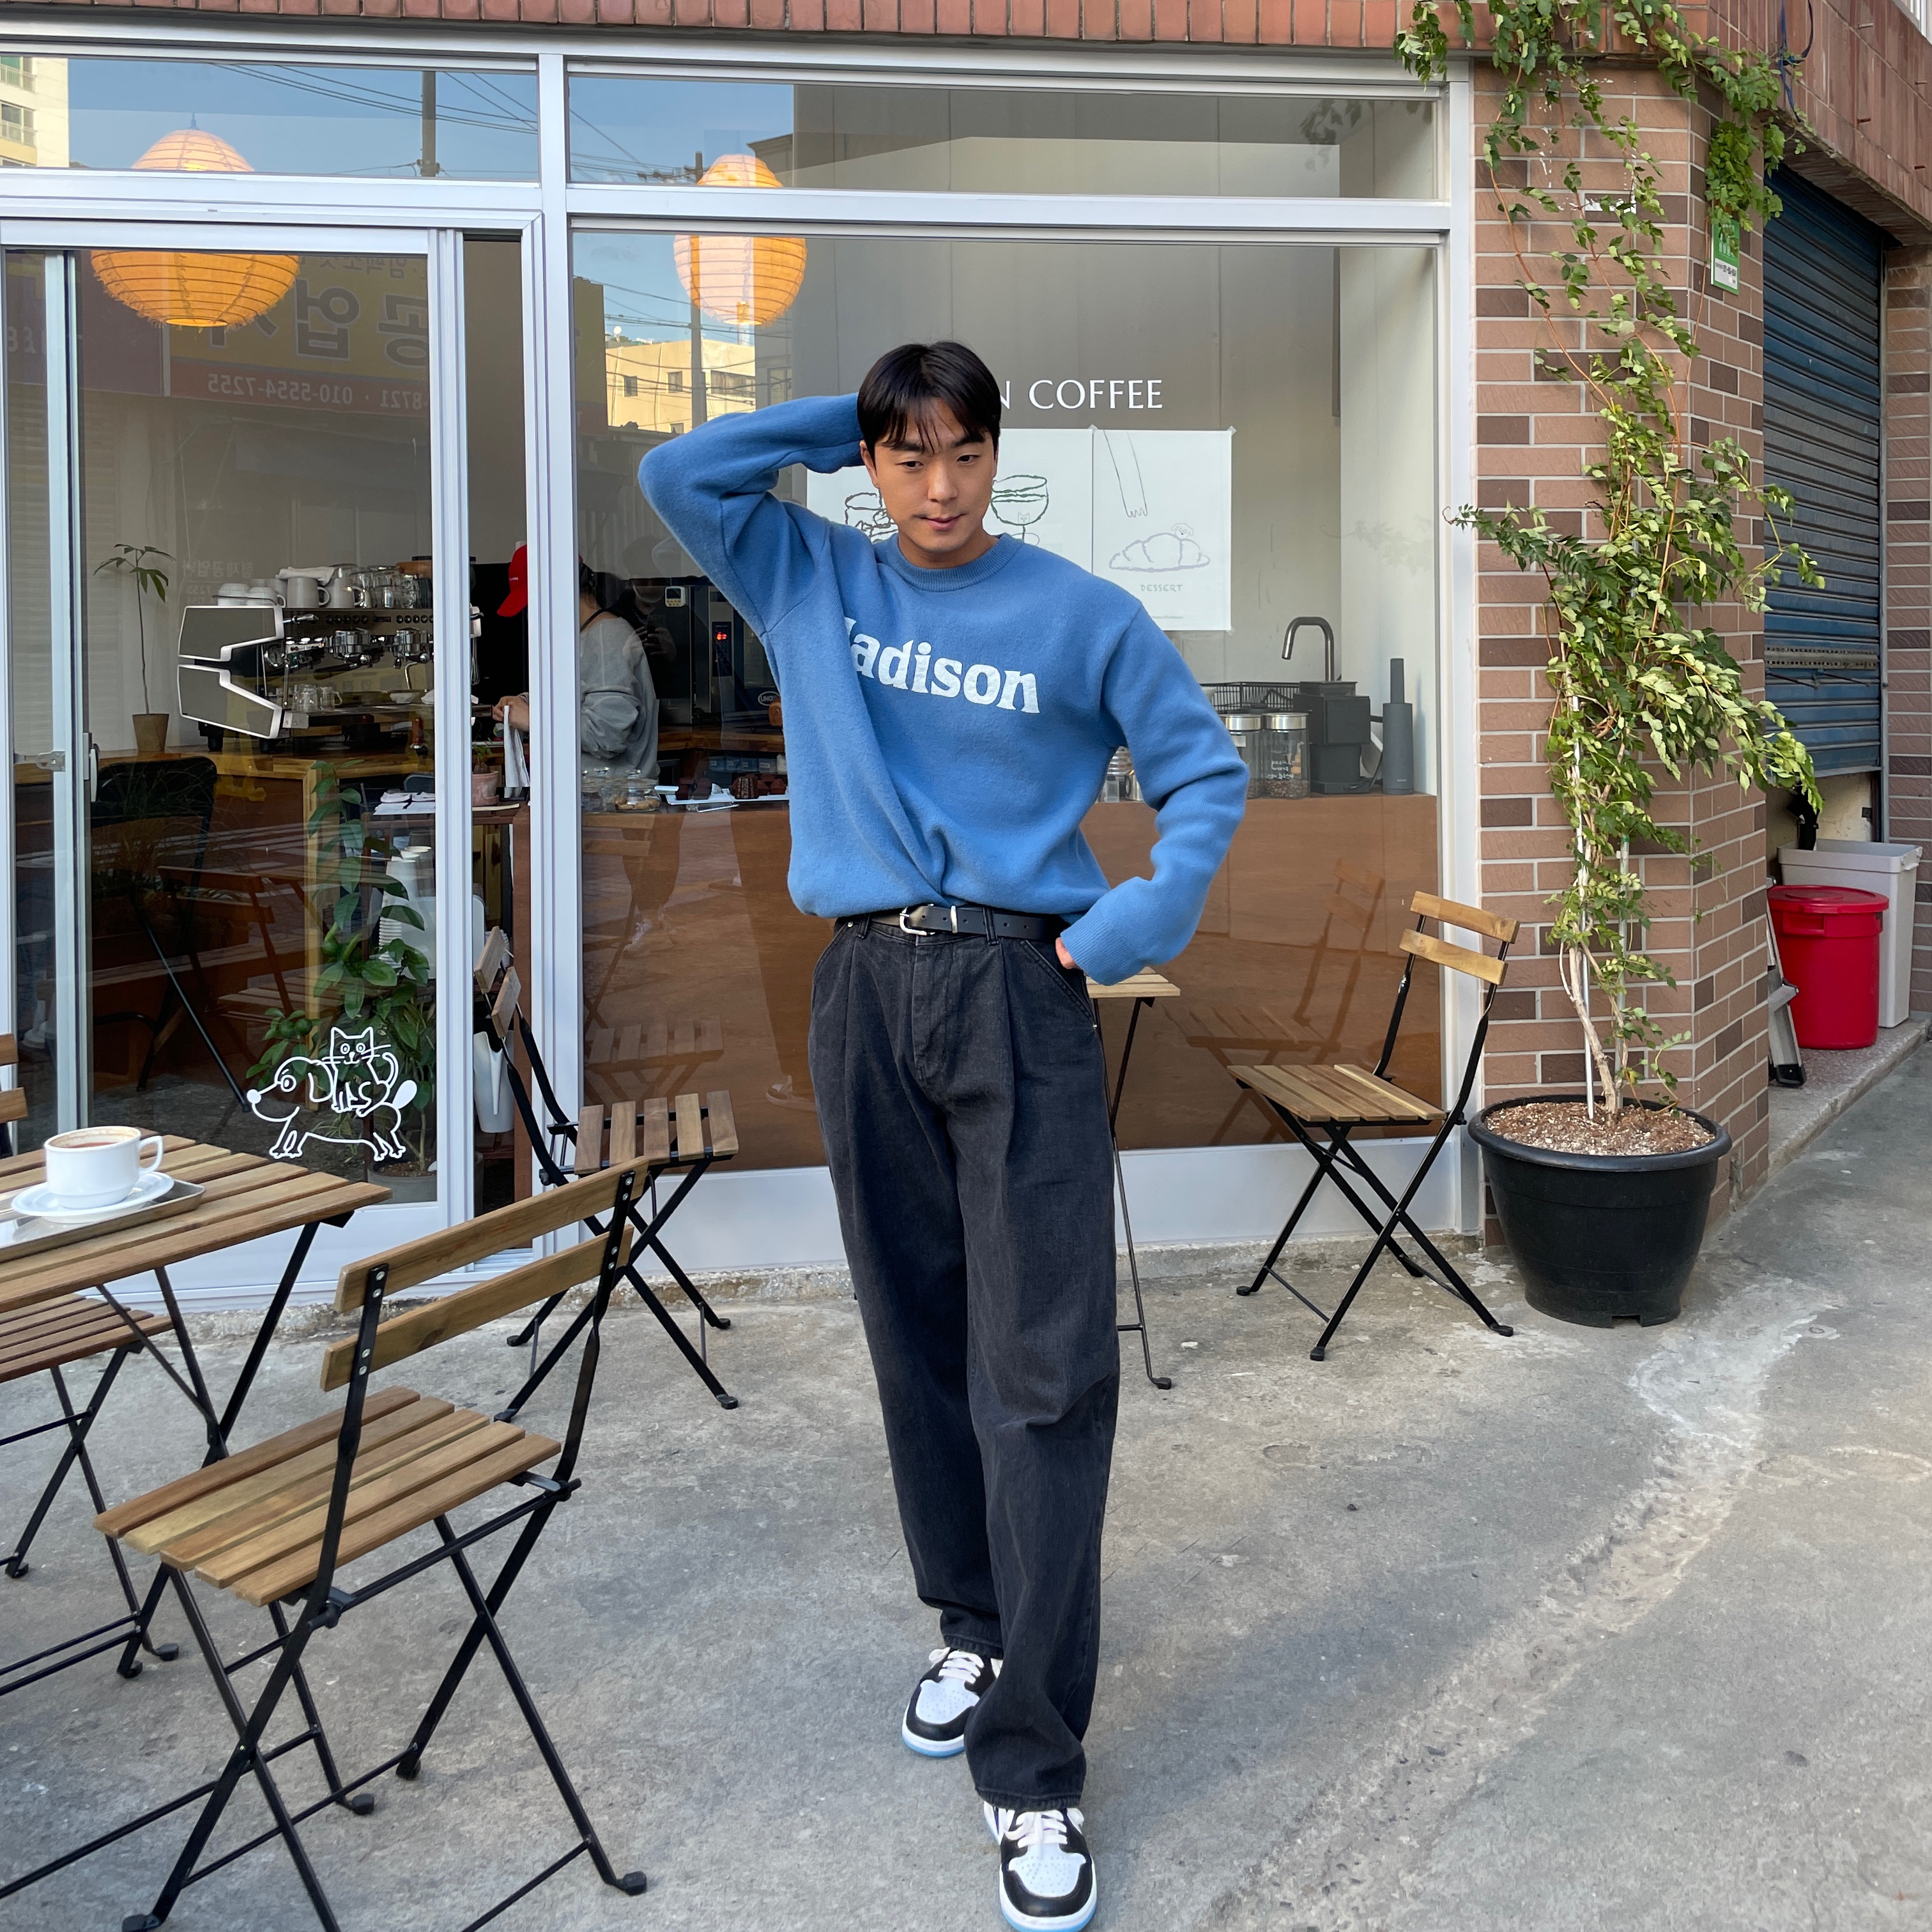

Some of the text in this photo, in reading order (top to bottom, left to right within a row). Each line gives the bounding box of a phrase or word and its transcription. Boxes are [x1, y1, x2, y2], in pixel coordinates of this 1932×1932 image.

[1028, 379, 1163, 410] COFFEE
[1140, 584, 1183, 592] DESSERT
[844, 617, 1040, 714] adison
